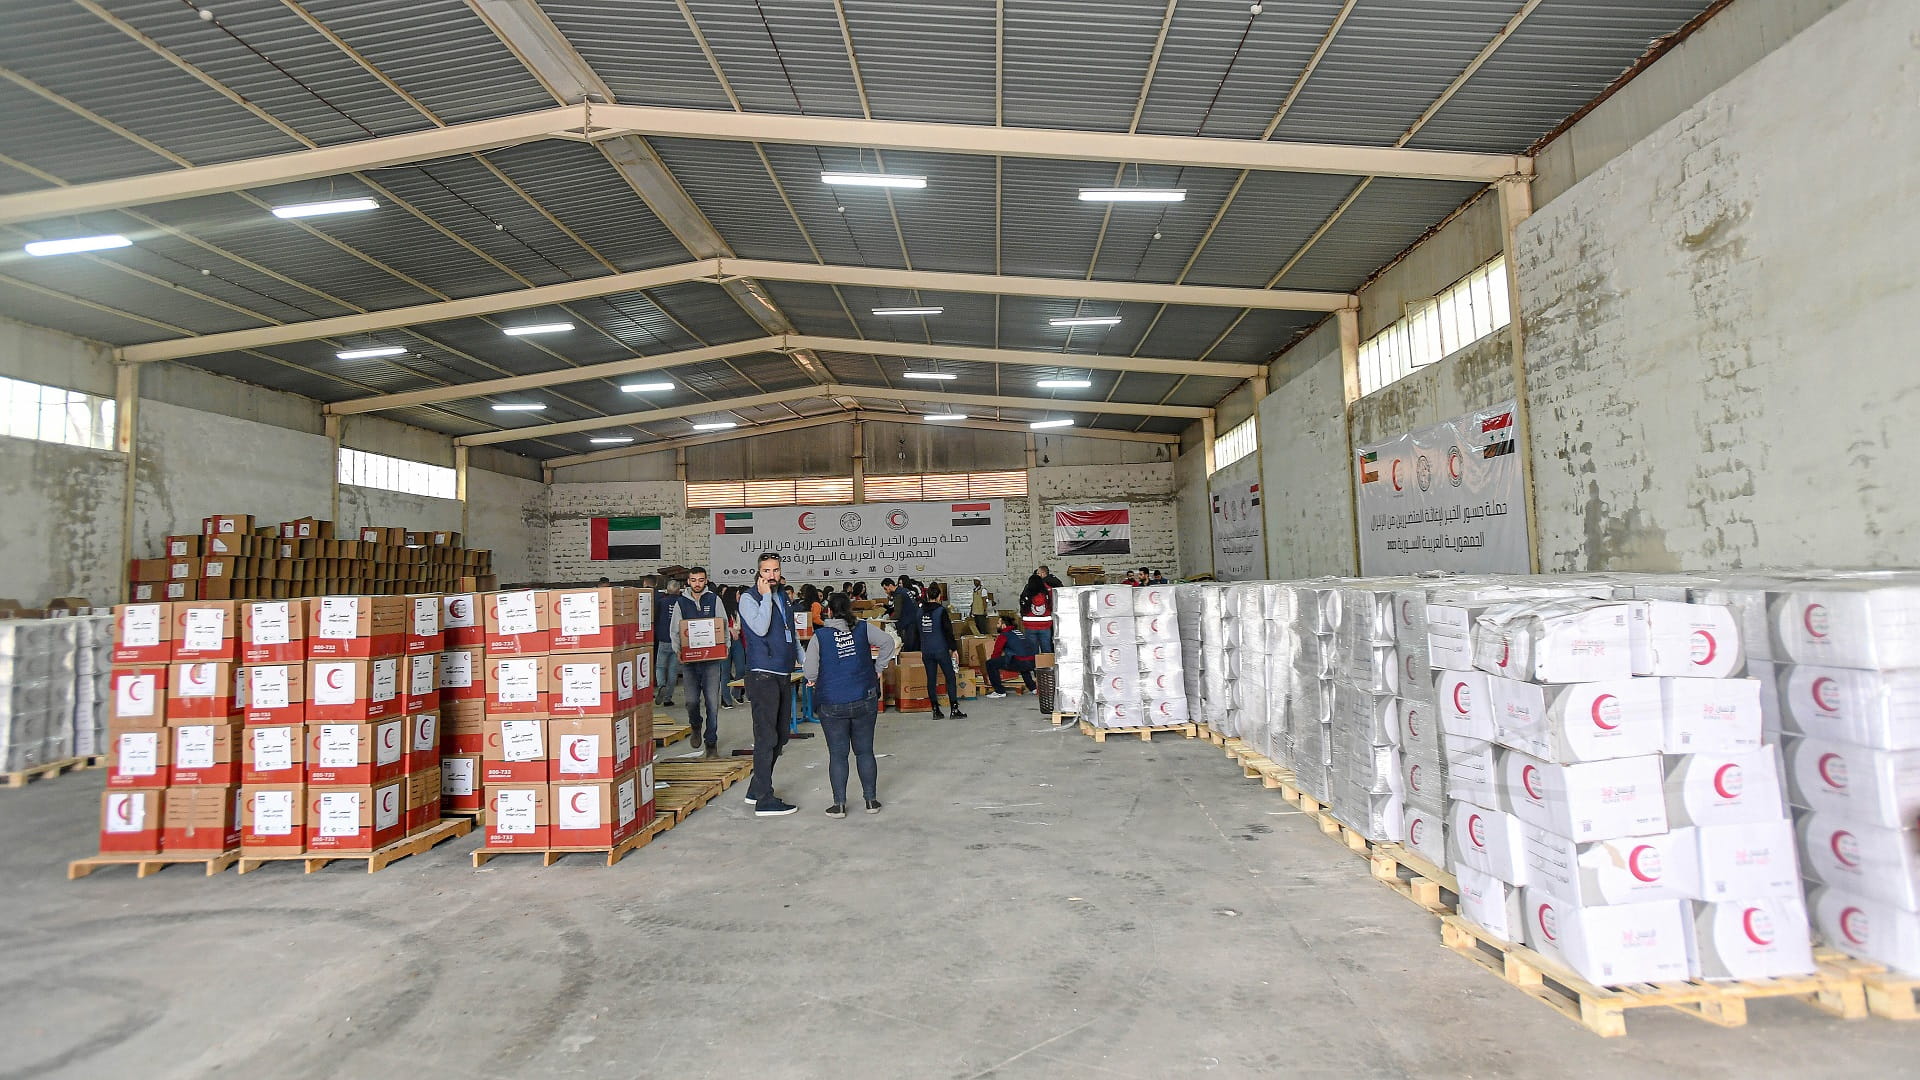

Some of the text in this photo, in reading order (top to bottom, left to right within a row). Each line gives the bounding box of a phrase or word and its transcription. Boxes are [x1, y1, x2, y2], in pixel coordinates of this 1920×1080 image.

[880, 535, 904, 547] الخير
[908, 535, 938, 546] جسور
[940, 533, 968, 543] حملة
[740, 540, 772, 552] الزلزال
[776, 541, 790, 552] من
[794, 552, 836, 564] السورية
[840, 550, 876, 562] العربية
[878, 548, 936, 561] الجمهورية
